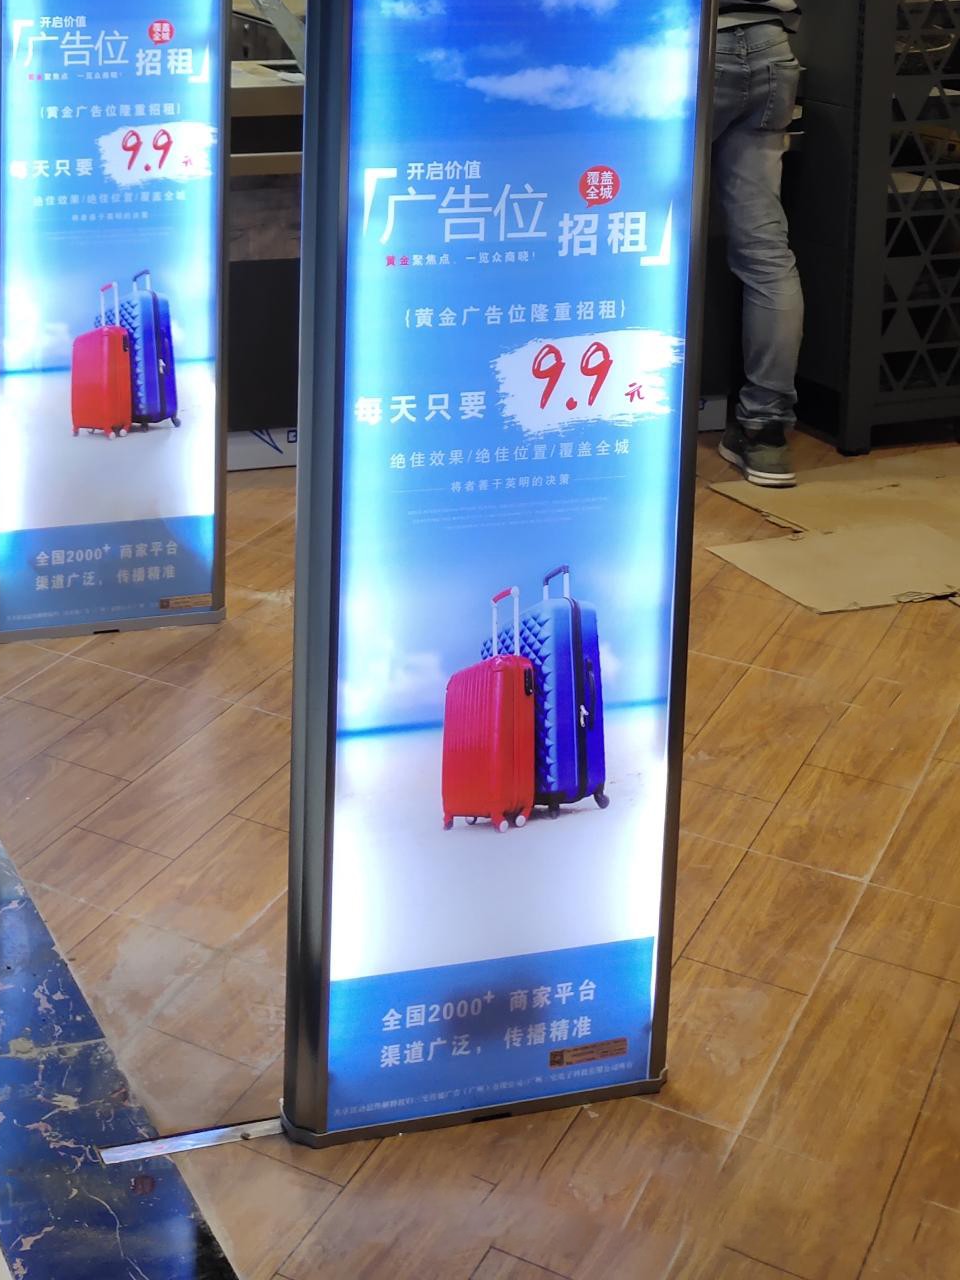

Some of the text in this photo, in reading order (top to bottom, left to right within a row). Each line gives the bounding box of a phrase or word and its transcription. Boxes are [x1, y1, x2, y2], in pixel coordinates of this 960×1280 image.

[40, 16, 87, 28] 开启价值
[23, 30, 129, 68] 广告位
[135, 48, 193, 76] 招租
[121, 129, 173, 172] 9.9
[407, 160, 481, 181] 开启价值
[586, 171, 614, 185] 覆盖
[585, 185, 613, 200] 全城
[379, 184, 548, 245] 广告位
[558, 211, 647, 257] 招租
[531, 341, 614, 411] 9.9
[354, 390, 488, 425] 每天只要
[624, 382, 645, 403] 元
[390, 438, 630, 470] 绝佳效果/绝佳位置/覆盖全城
[119, 540, 179, 559] 商家平台
[381, 979, 598, 1032] 全国2000+ 商家平台
